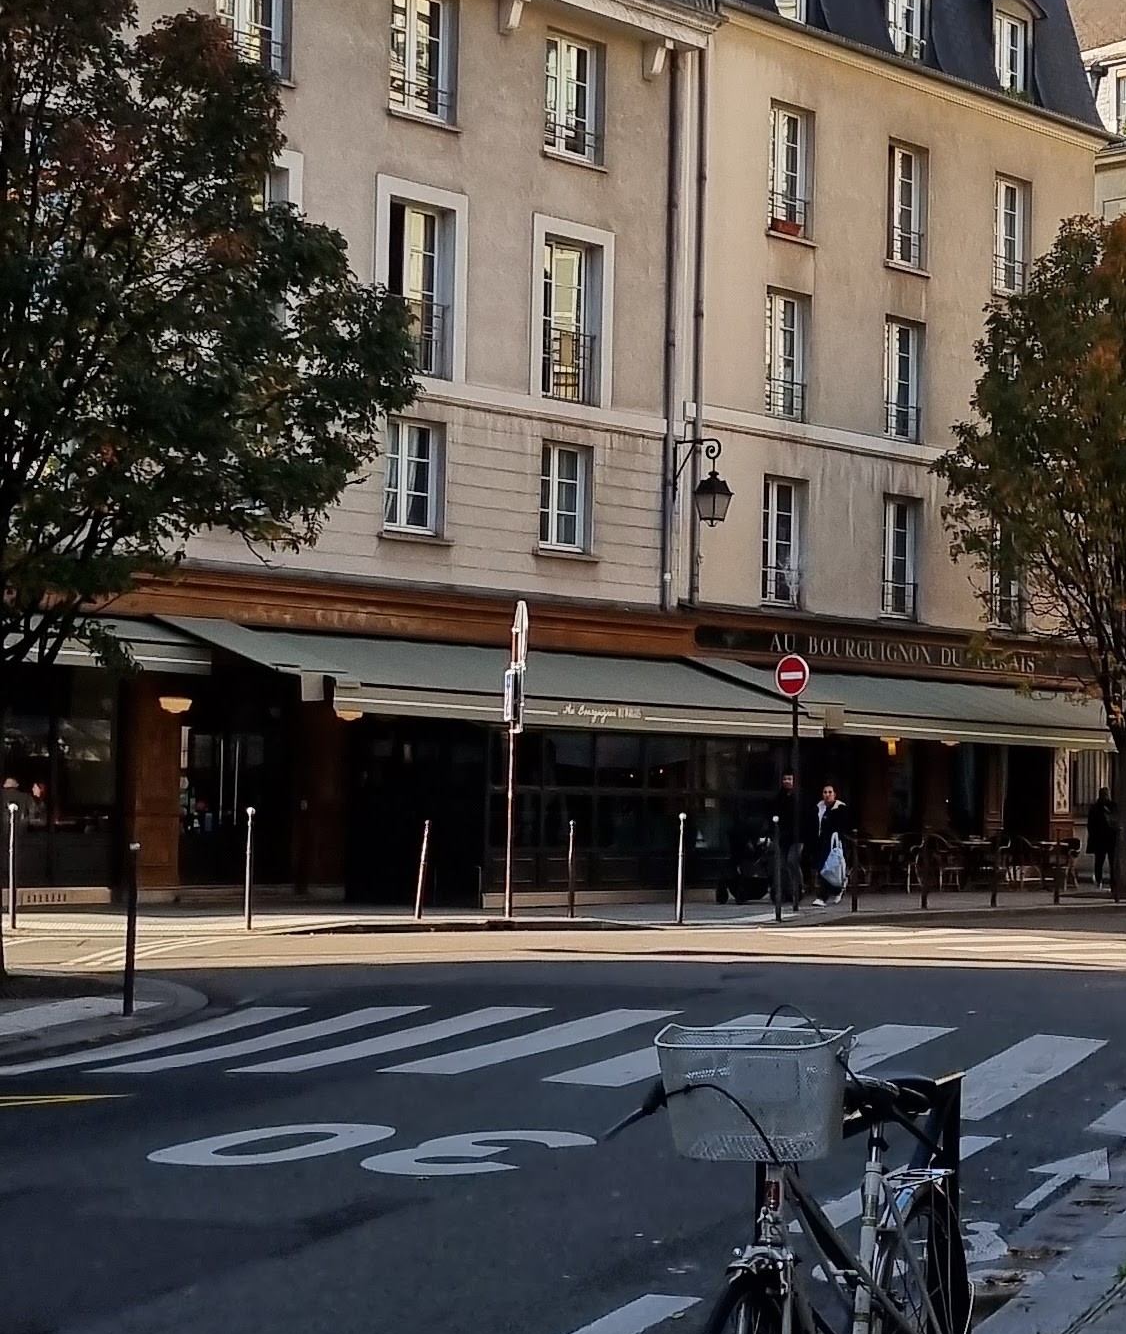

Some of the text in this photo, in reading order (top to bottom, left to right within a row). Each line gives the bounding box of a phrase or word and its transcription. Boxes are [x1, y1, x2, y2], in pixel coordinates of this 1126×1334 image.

[769, 633, 796, 653] AU
[808, 636, 932, 664] BOURGUIGNON
[941, 647, 963, 667] DU
